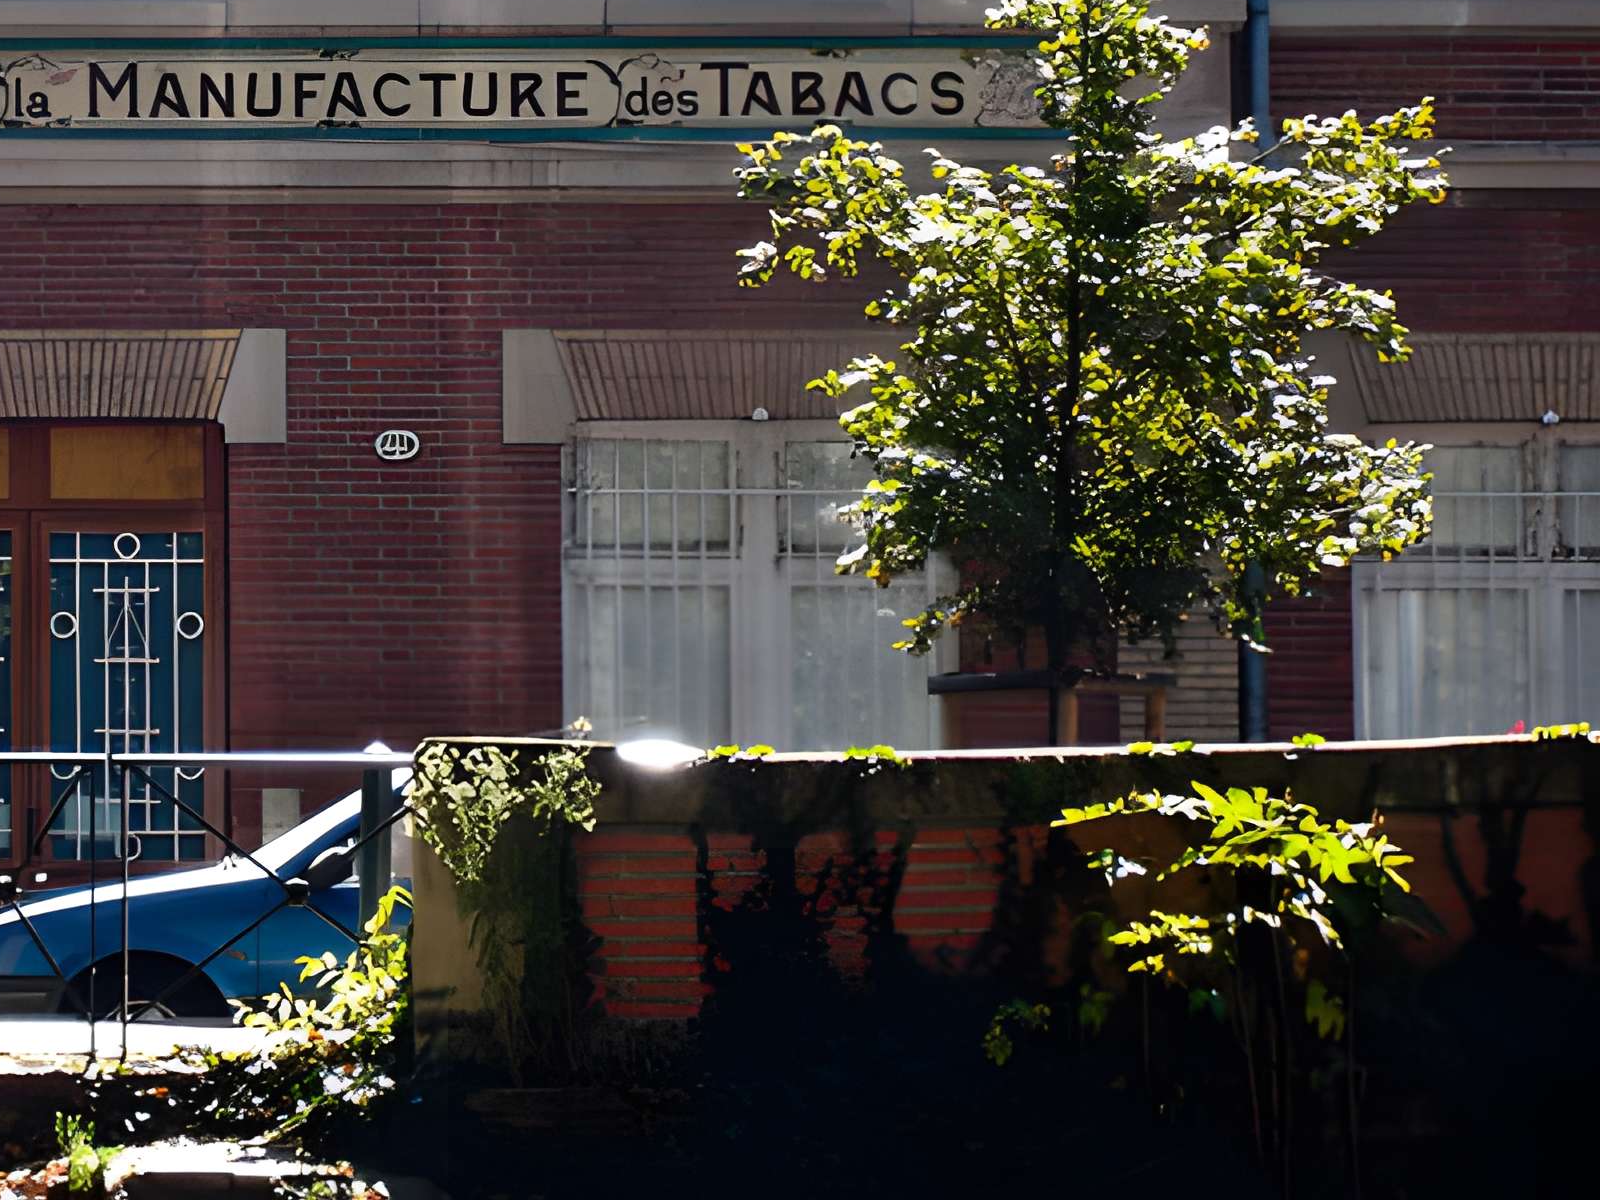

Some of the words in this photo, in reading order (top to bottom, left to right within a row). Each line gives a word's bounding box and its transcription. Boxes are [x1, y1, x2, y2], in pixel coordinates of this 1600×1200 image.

[87, 61, 589, 118] MANUFACTURE
[624, 76, 699, 117] des
[699, 61, 965, 118] TABACS
